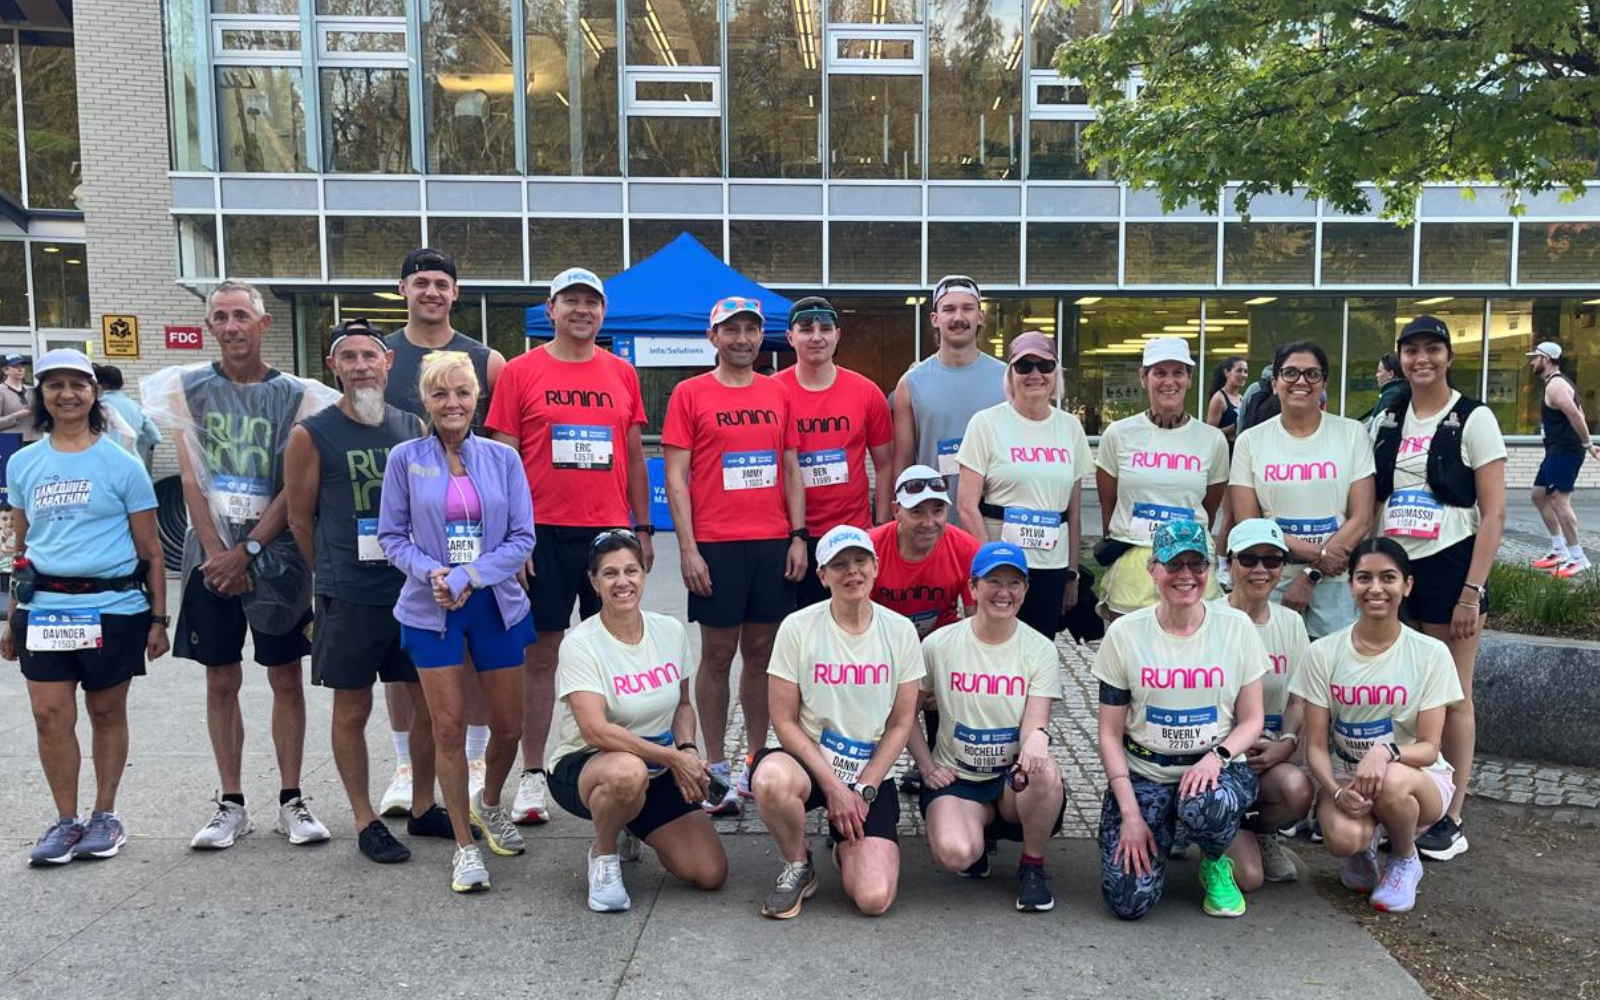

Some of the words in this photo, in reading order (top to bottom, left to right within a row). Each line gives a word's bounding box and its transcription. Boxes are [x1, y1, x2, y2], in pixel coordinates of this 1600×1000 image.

[568, 273, 597, 284] HOKA
[169, 332, 198, 343] FDC
[650, 347, 704, 355] Info/Solutions
[575, 442, 592, 453] ERIC
[346, 447, 391, 480] RU
[813, 467, 828, 477] BEN
[34, 480, 92, 499] VANCOUVER
[35, 493, 90, 511] MARATHON
[1020, 527, 1045, 538] SYLVIA
[829, 532, 861, 547] HOKA
[43, 628, 86, 640] DAVINDER
[51, 640, 77, 649] 21503
[1162, 727, 1201, 740] BEVERLY
[1168, 739, 1195, 749] 22767
[964, 744, 1006, 756] ROCHELLE
[831, 755, 860, 772] DANNA
